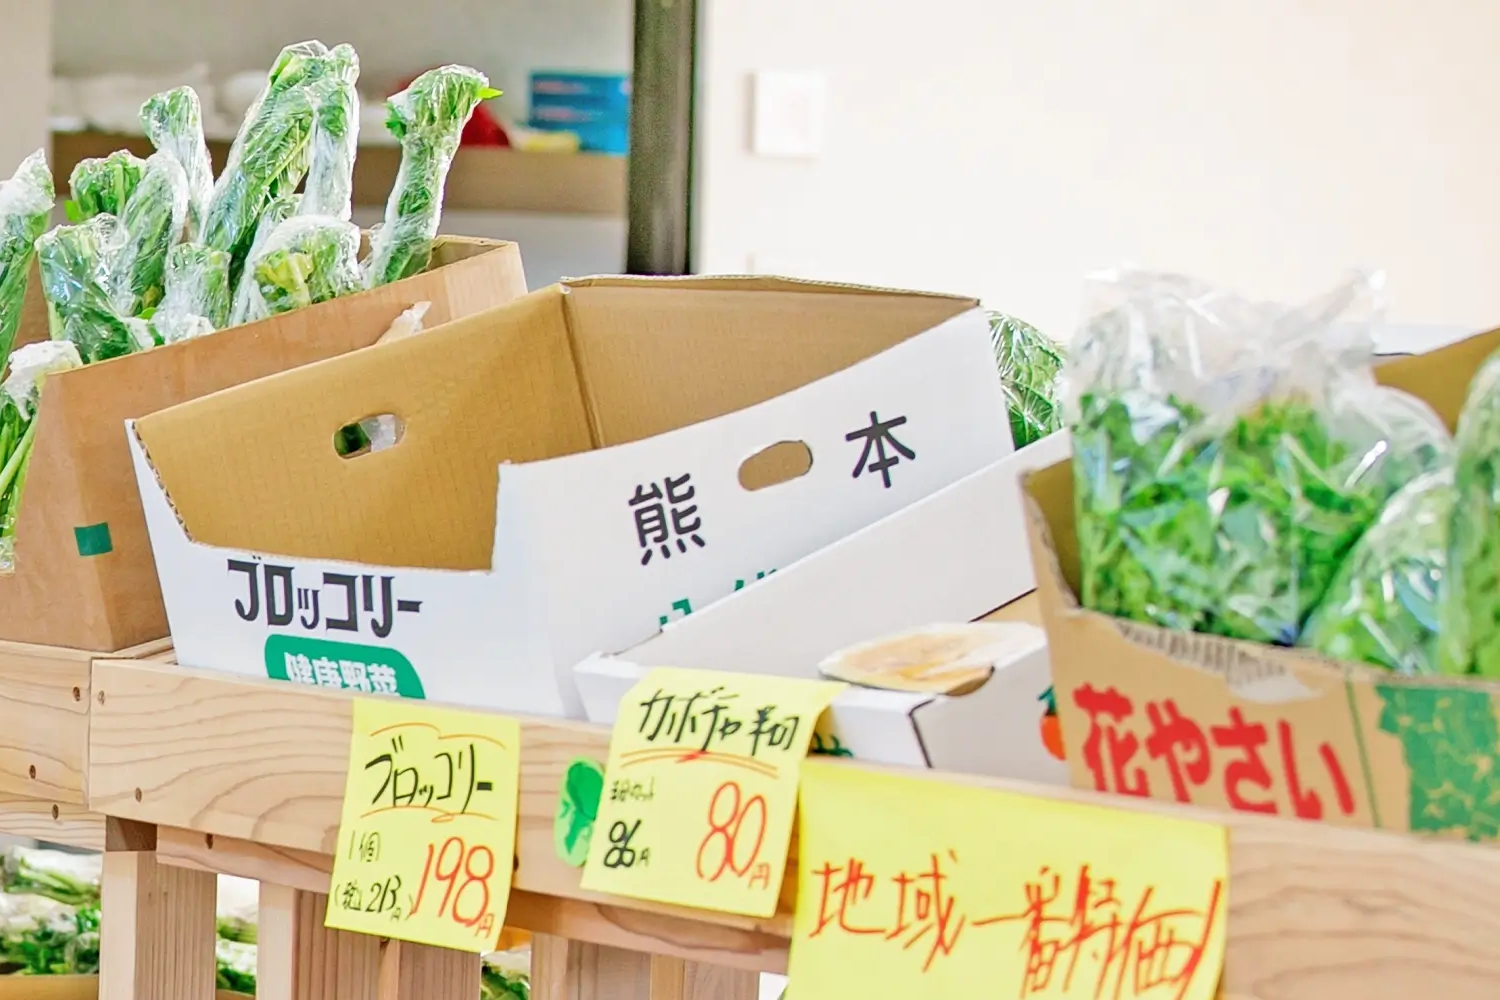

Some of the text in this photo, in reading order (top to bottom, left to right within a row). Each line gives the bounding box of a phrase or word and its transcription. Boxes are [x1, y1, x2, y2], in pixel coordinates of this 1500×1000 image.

[226, 557, 424, 638] ブロッコリー
[364, 735, 493, 815] ブロッコリー
[1072, 682, 1357, 822] 花やさい
